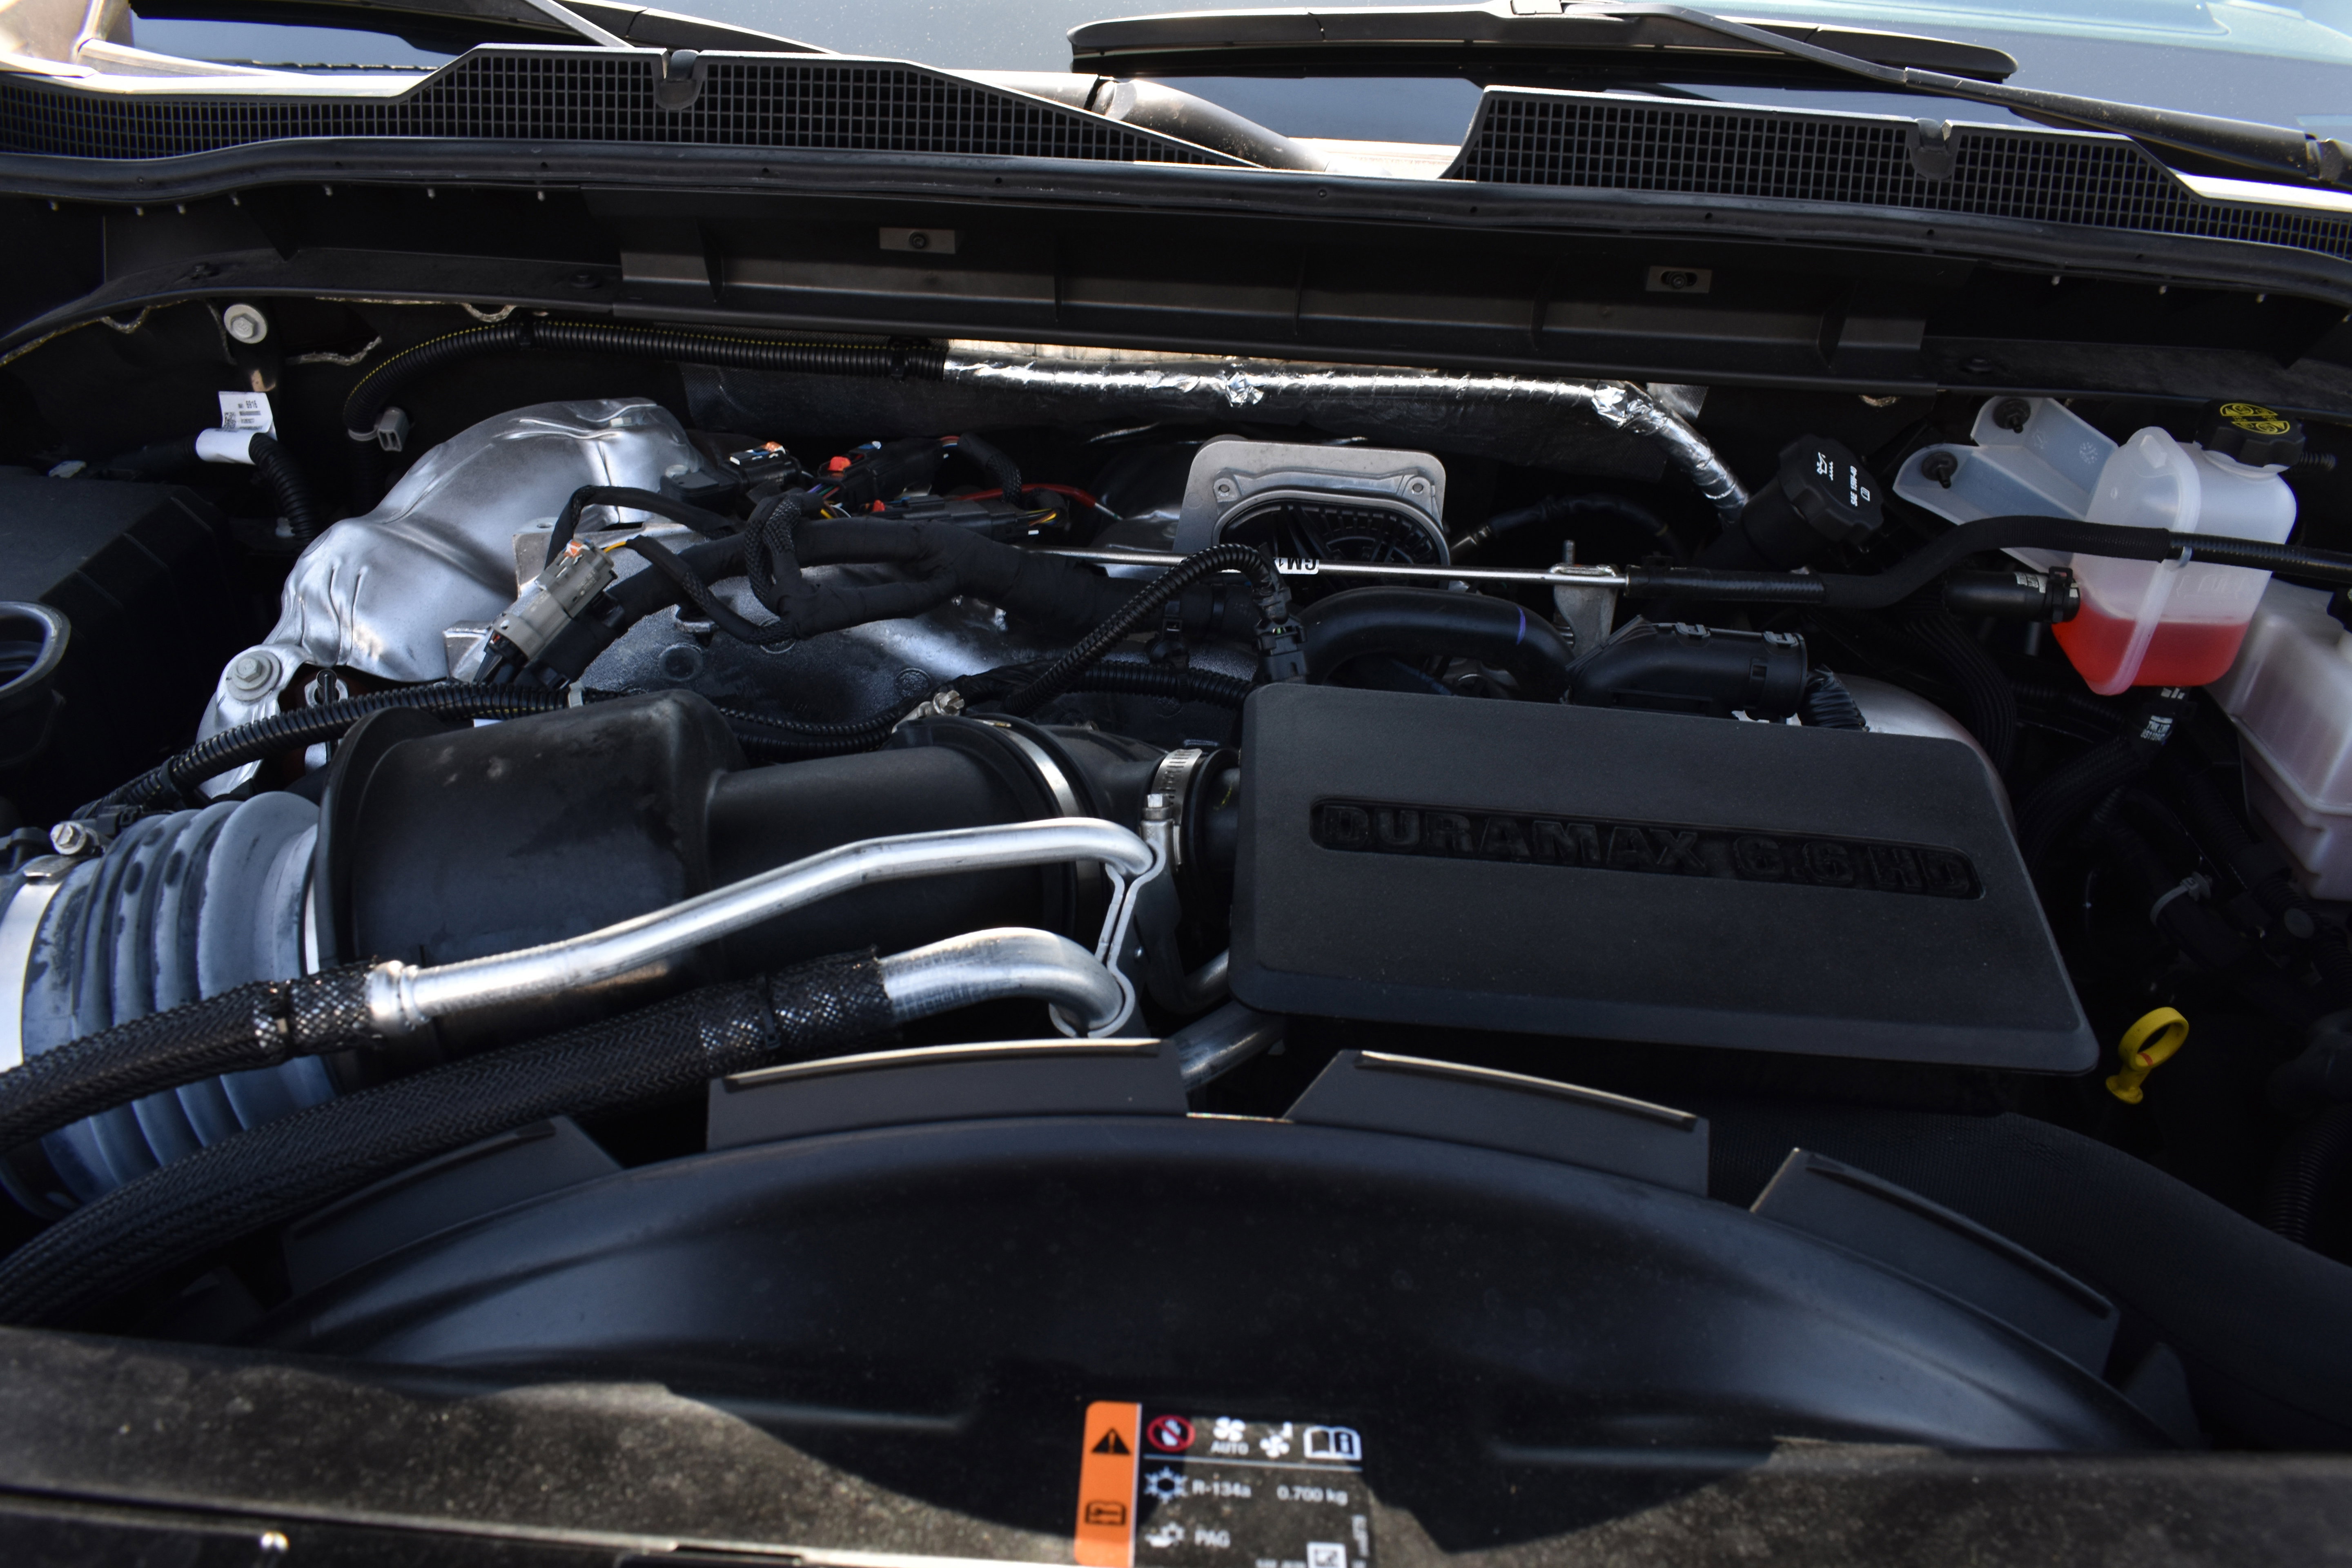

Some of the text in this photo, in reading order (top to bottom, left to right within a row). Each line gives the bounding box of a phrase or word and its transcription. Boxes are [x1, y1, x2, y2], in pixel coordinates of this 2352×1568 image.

[1322, 804, 1707, 871] DURAMAX
[1210, 1440, 1249, 1456] AUTO
[1192, 1479, 1348, 1507] R-134a 0.700 kg
[1194, 1529, 1231, 1548] PAG
